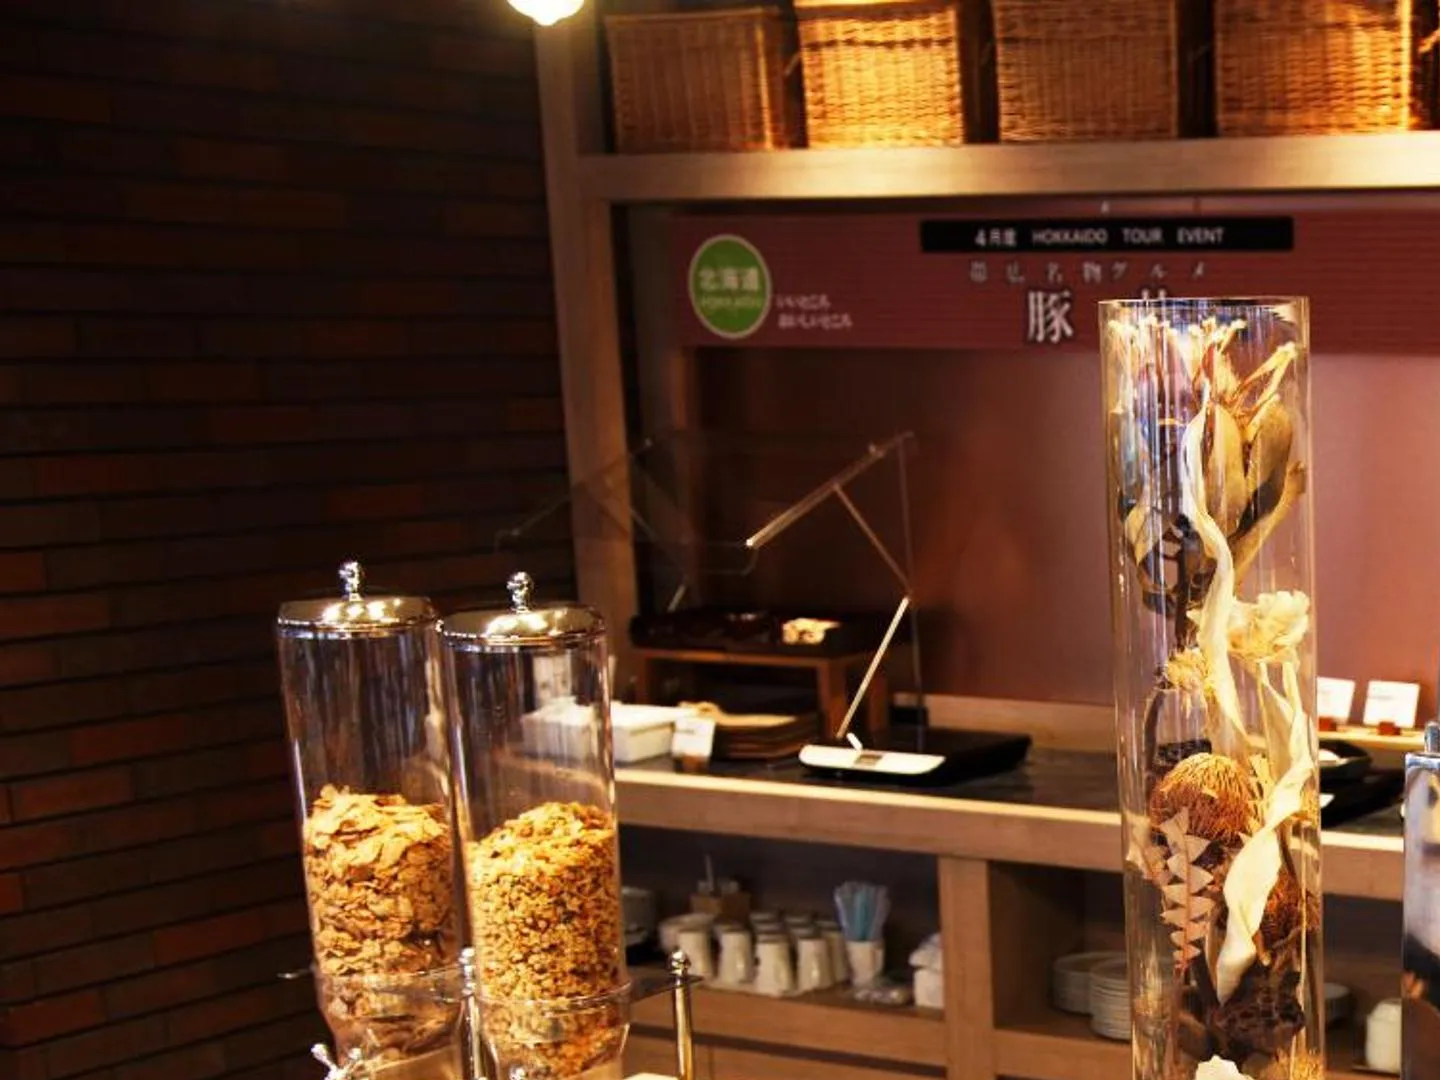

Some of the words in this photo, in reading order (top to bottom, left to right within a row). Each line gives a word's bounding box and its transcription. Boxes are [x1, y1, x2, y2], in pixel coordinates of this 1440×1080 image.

[1032, 228, 1108, 245] HOKKAIDO
[1123, 228, 1163, 244] TOUR
[1177, 227, 1225, 244] EVENT
